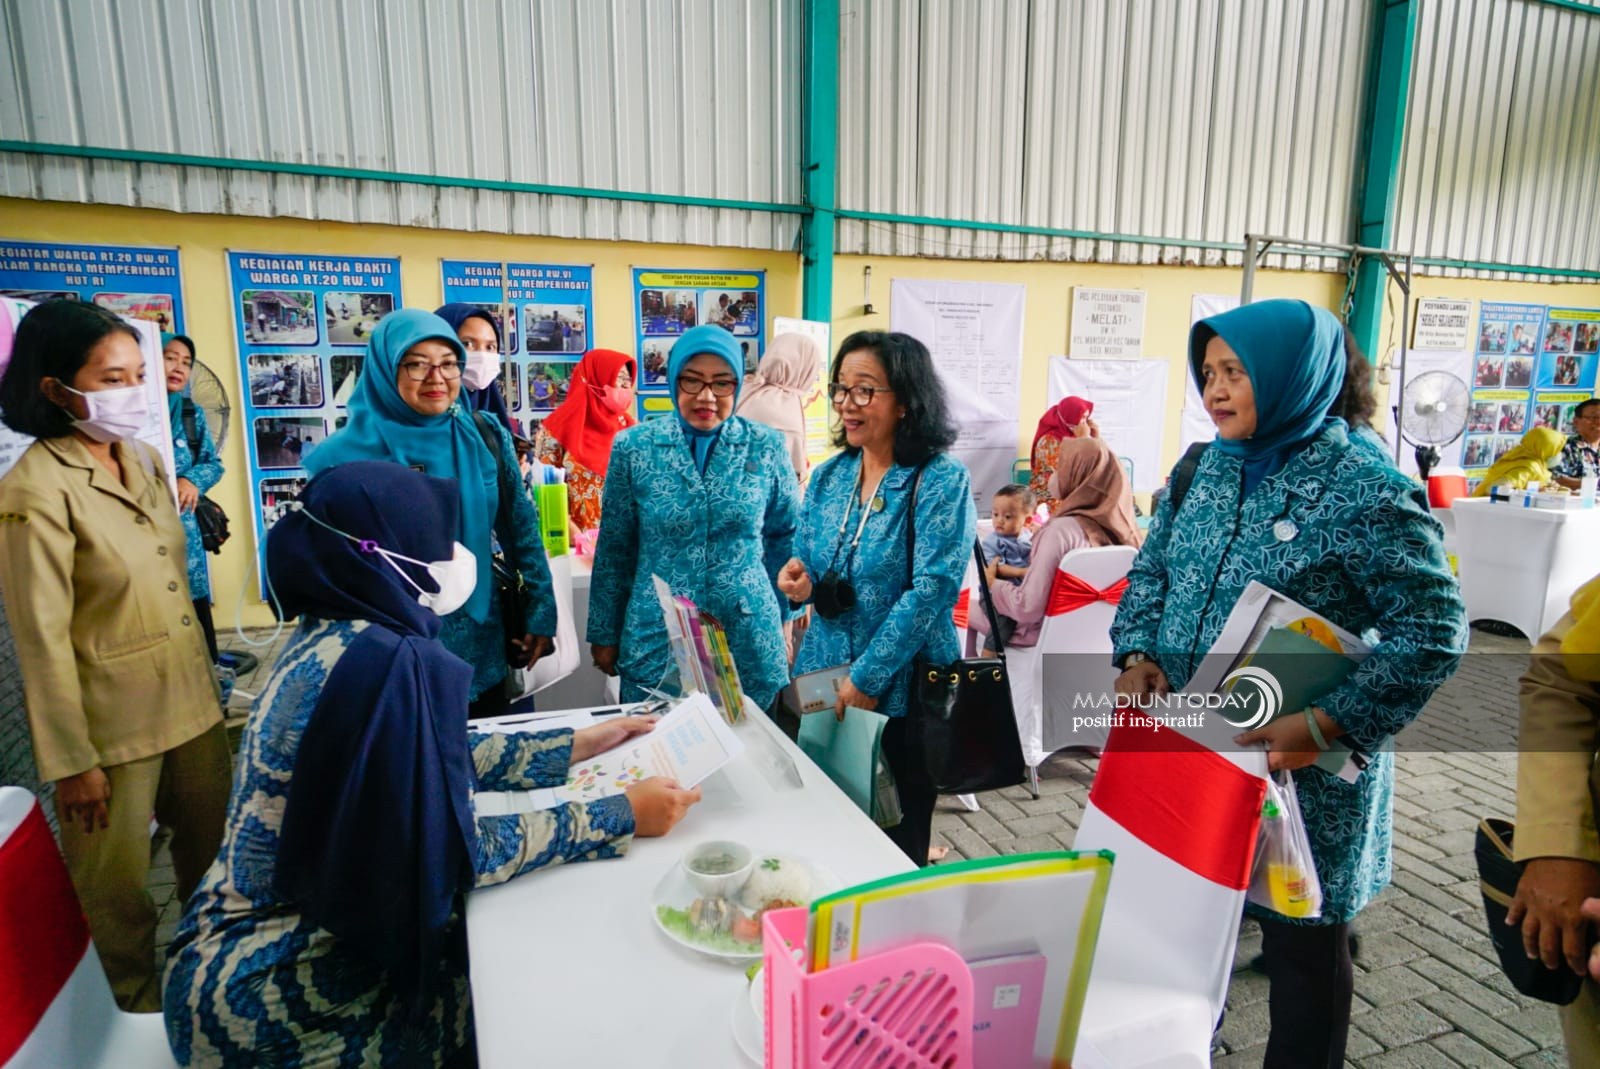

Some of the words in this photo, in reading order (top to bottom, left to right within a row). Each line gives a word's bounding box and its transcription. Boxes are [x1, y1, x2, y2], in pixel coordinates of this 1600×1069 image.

[0, 247, 50, 259] EGIATAN
[53, 250, 97, 260] WARGA
[100, 252, 132, 262] RT.20
[136, 253, 169, 264] RW.VI
[0, 260, 30, 271] LAM
[34, 261, 83, 273] RANGKA
[86, 263, 176, 276] MEMPERINGATI
[239, 258, 304, 271] KEGIATAN
[309, 260, 351, 272] KERJA
[355, 262, 392, 274] BAKTI
[464, 266, 503, 277] KEGIATA
[511, 268, 544, 278] WARGA
[546, 270, 572, 279] RW.VI
[65, 275, 88, 285] HUT
[92, 276, 105, 286] RI
[250, 272, 299, 284] WARGA
[303, 274, 339, 286] RT.20
[343, 275, 368, 287] RW.
[371, 276, 384, 287] VI
[447, 277, 480, 287] DALAM
[482, 278, 519, 288] RANKA
[521, 279, 589, 290] MEMPERINGATI
[525, 290, 535, 299] RI
[1090, 313, 1127, 325] MELATI
